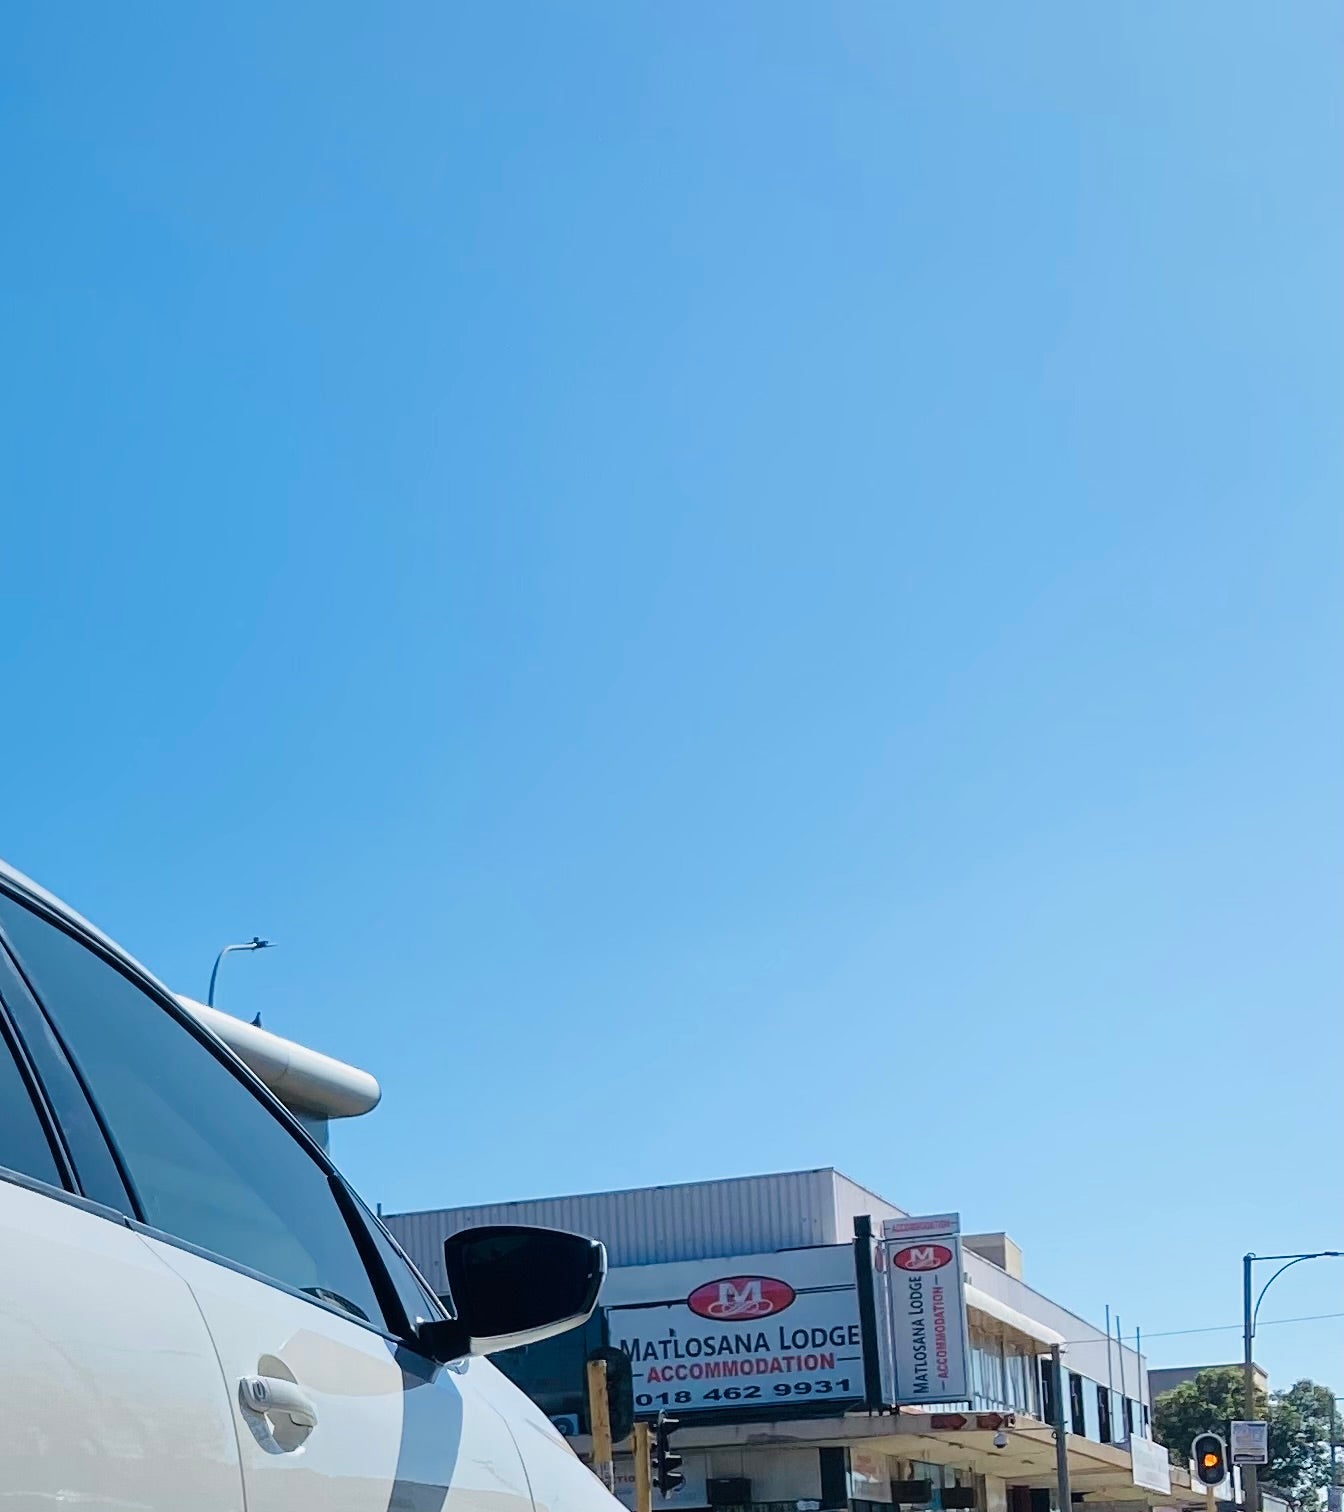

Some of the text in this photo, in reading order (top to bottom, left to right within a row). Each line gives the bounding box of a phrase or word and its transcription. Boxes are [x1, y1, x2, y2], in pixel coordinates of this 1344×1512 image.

[620, 1324, 861, 1362] MATLOSANA LODGE
[909, 1275, 929, 1394] MATLOSANA LODGE
[932, 1286, 949, 1379] ACCOMMODATION
[647, 1352, 836, 1384] ACCOMMODATION
[635, 1379, 851, 1407] 018 462 9931
